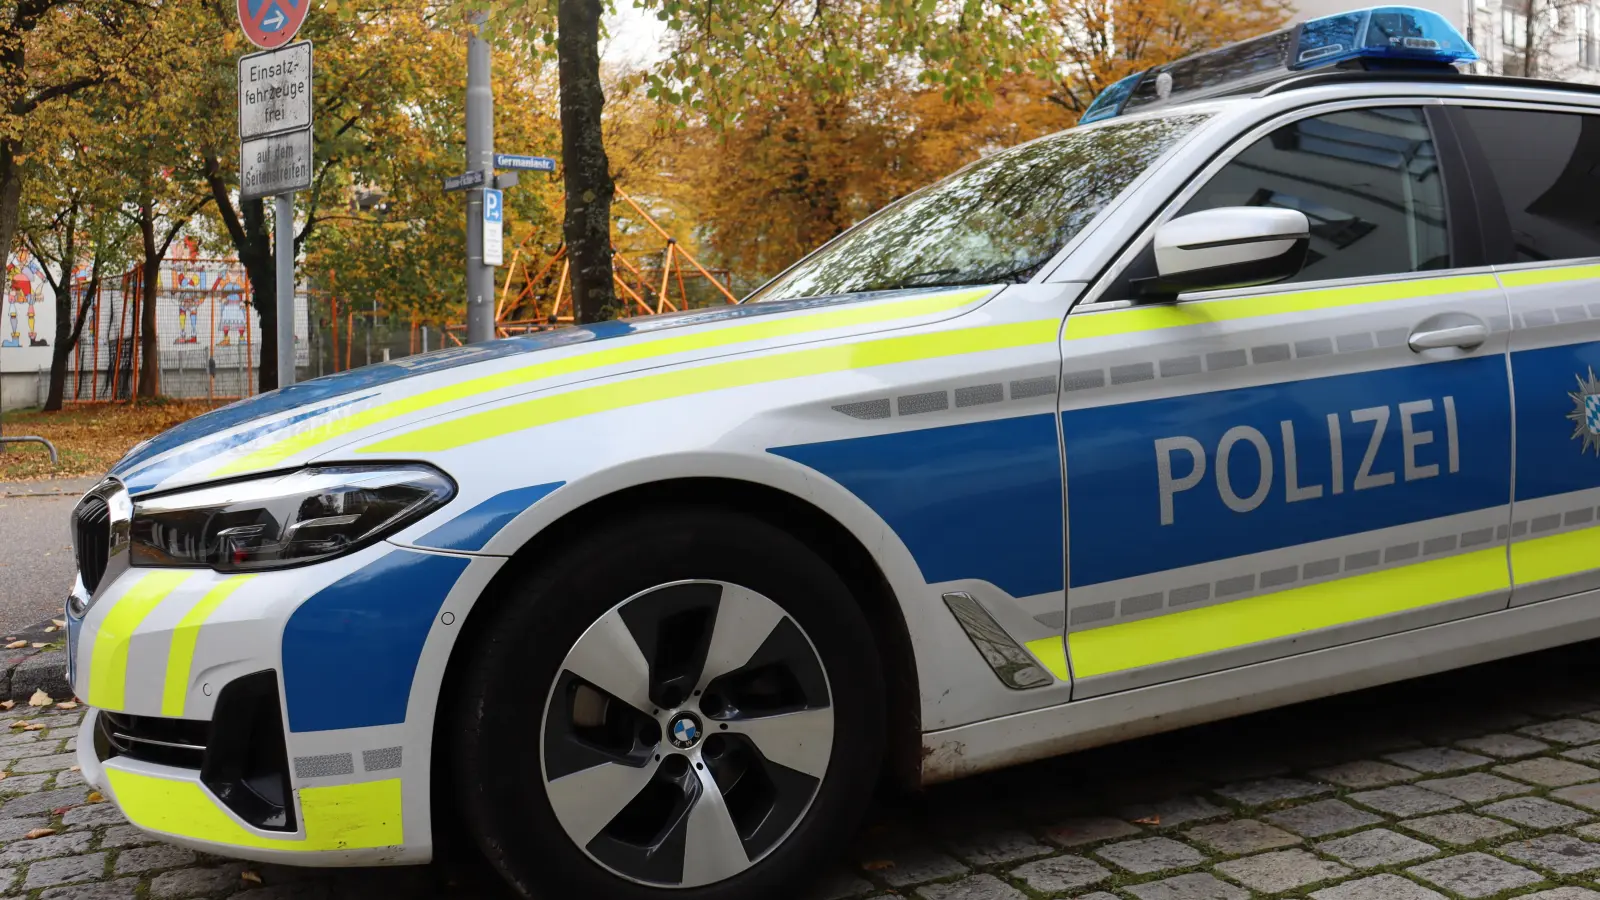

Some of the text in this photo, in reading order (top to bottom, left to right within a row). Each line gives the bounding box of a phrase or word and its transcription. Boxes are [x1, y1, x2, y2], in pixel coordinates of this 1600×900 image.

[250, 60, 299, 82] Einsatz-
[246, 81, 304, 105] fahrzeuge
[265, 105, 285, 123] frei
[257, 144, 293, 163] auf dem
[246, 162, 306, 187] Seitenstreifen
[487, 193, 497, 218] P
[1154, 396, 1459, 526] POLIZEI
